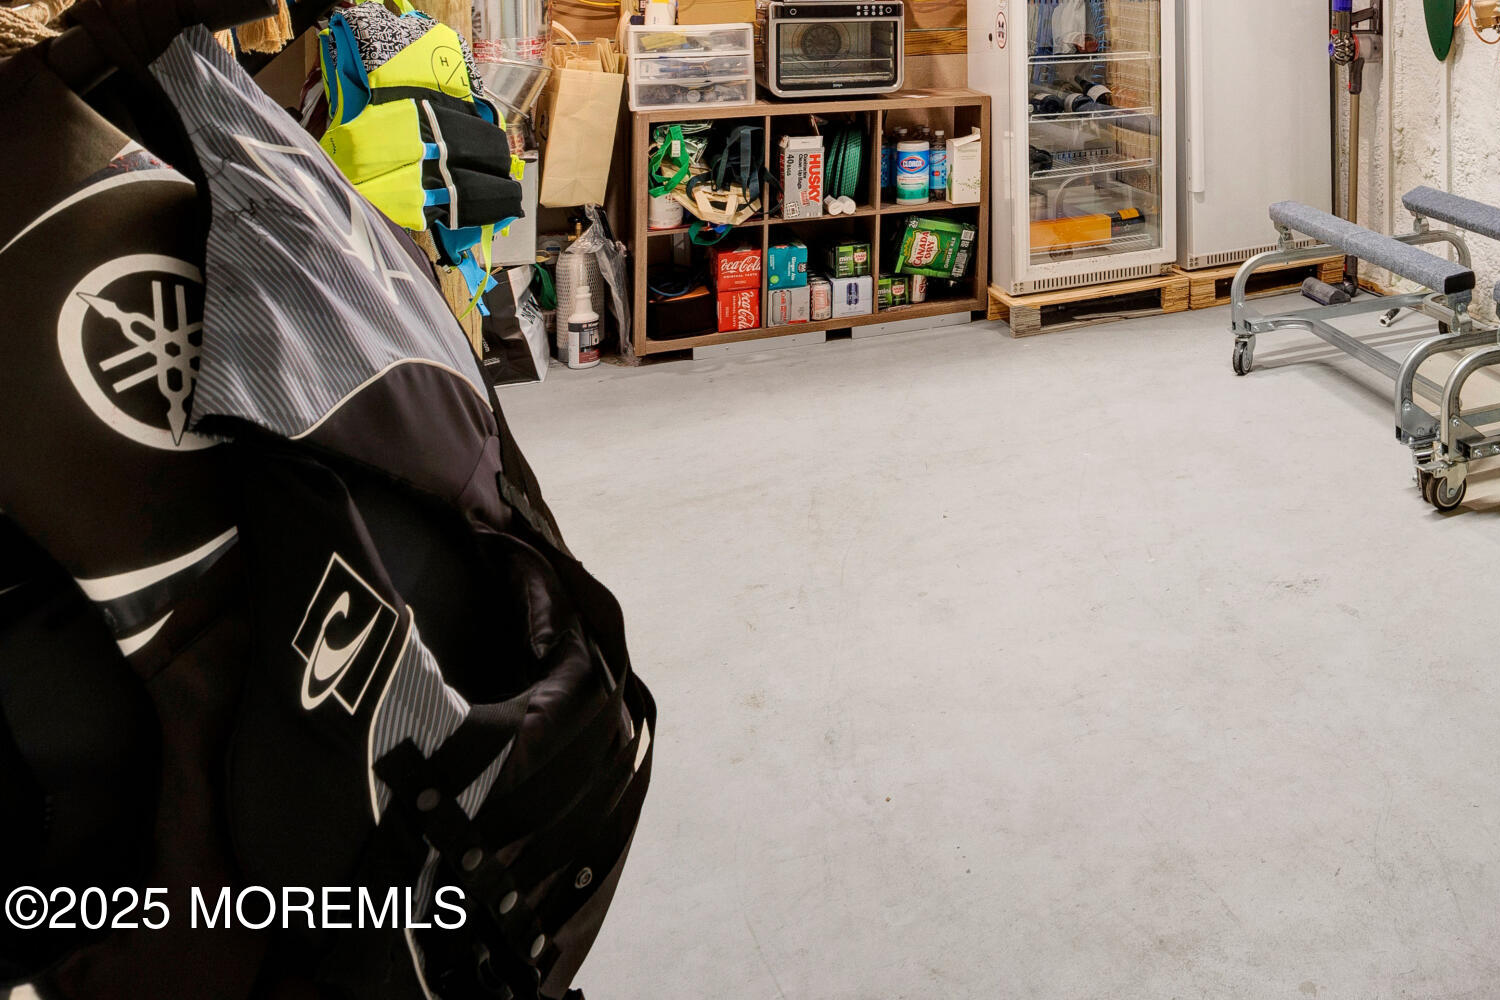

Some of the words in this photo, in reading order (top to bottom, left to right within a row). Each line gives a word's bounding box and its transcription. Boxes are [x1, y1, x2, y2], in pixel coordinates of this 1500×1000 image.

[787, 154, 794, 164] 40
[902, 159, 922, 168] CLOROX
[808, 153, 821, 203] HUSKY
[912, 231, 930, 267] CANADA
[924, 240, 935, 260] DRY
[944, 248, 954, 269] GINGER
